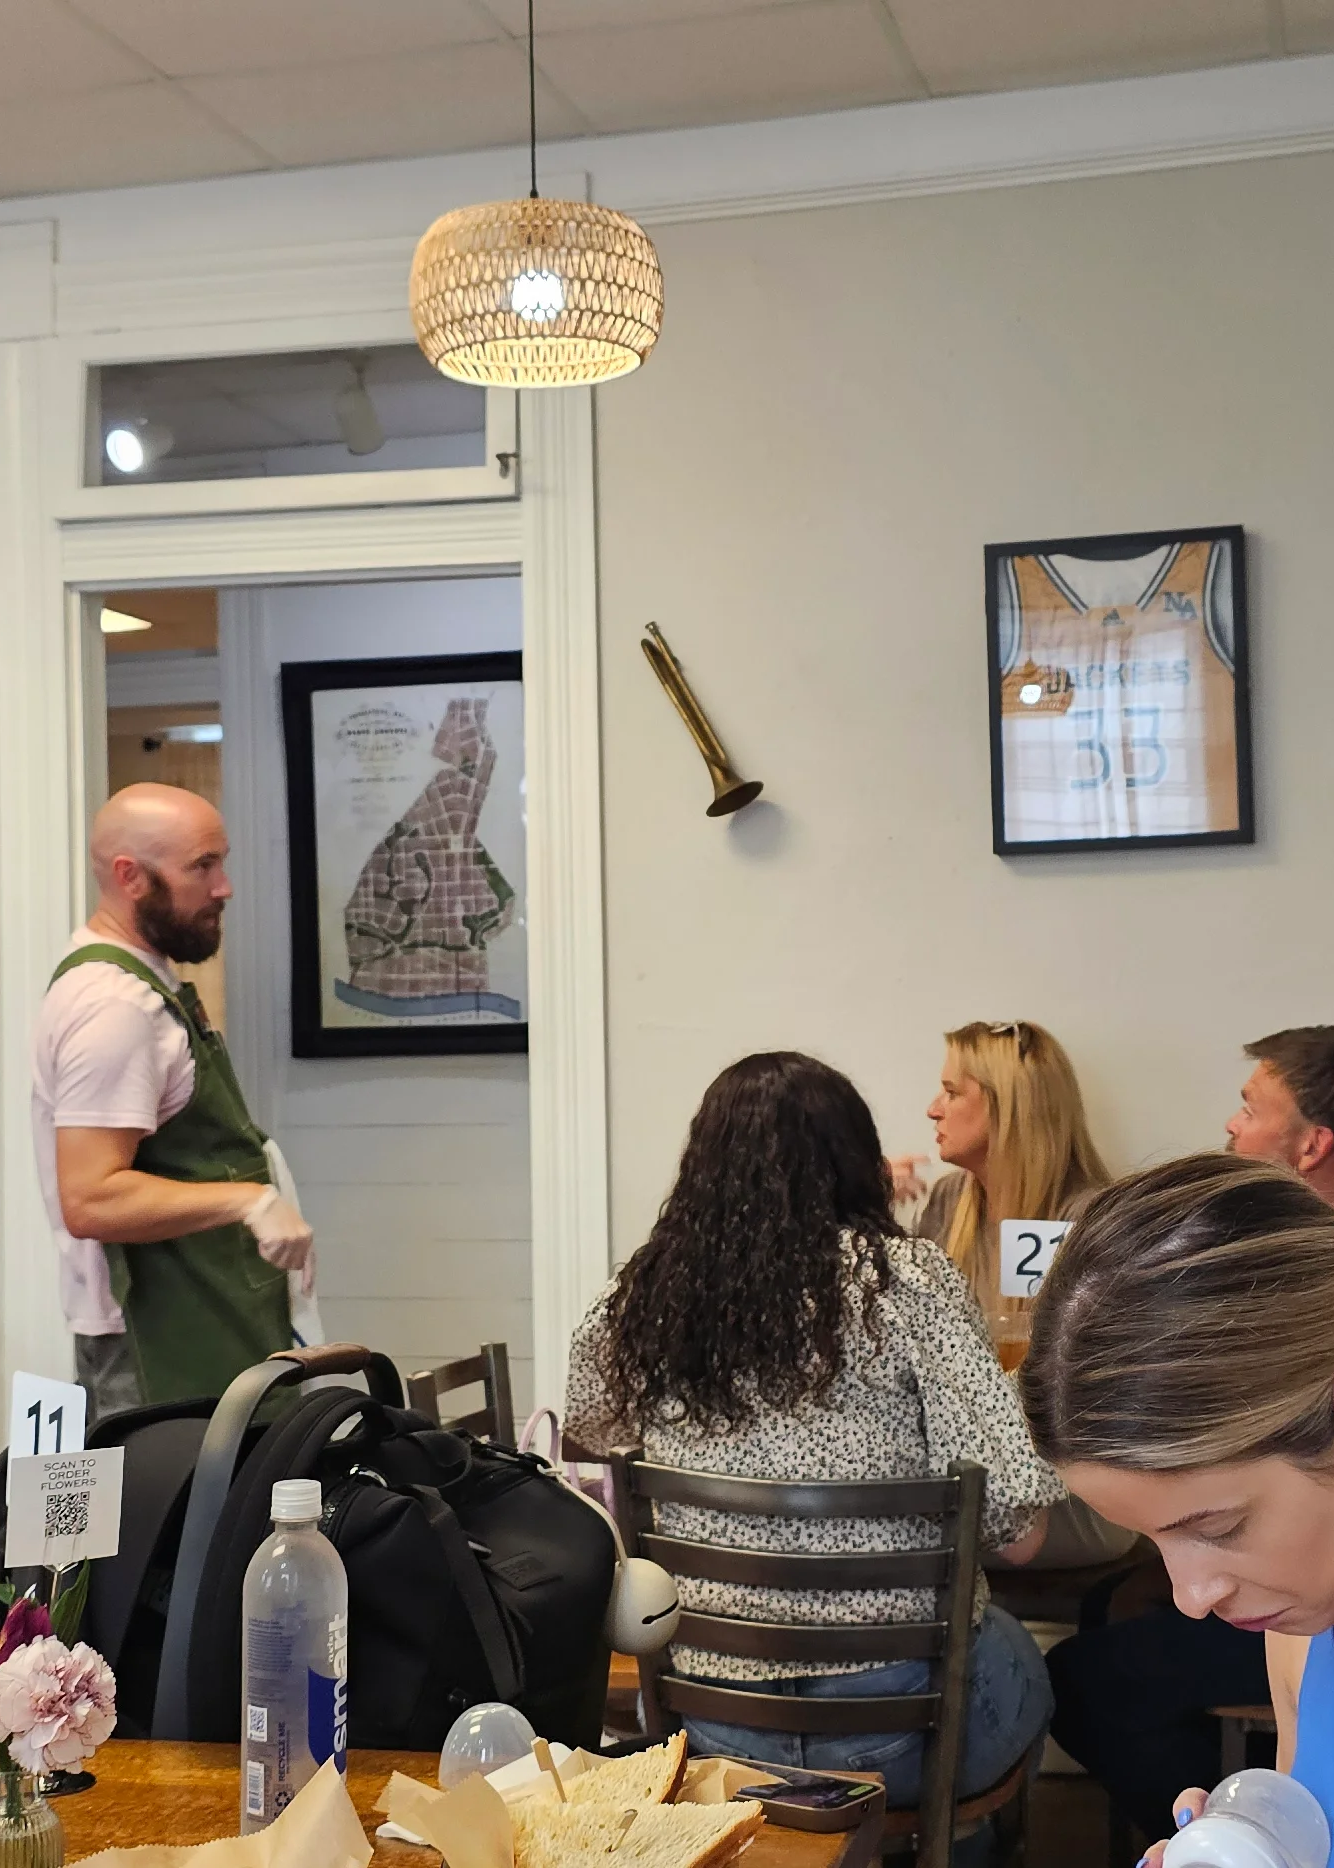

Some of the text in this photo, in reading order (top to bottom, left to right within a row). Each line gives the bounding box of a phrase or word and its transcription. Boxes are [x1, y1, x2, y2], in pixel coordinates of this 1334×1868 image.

[1066, 704, 1169, 790] 33
[27, 1400, 64, 1456] 11
[40, 1477, 97, 1491] FLOWERS
[43, 1458, 96, 1472] SCAN TO
[48, 1468, 91, 1481] ORDER
[326, 1614, 348, 1754] smart
[278, 1721, 286, 1782] RECYCLE ME
